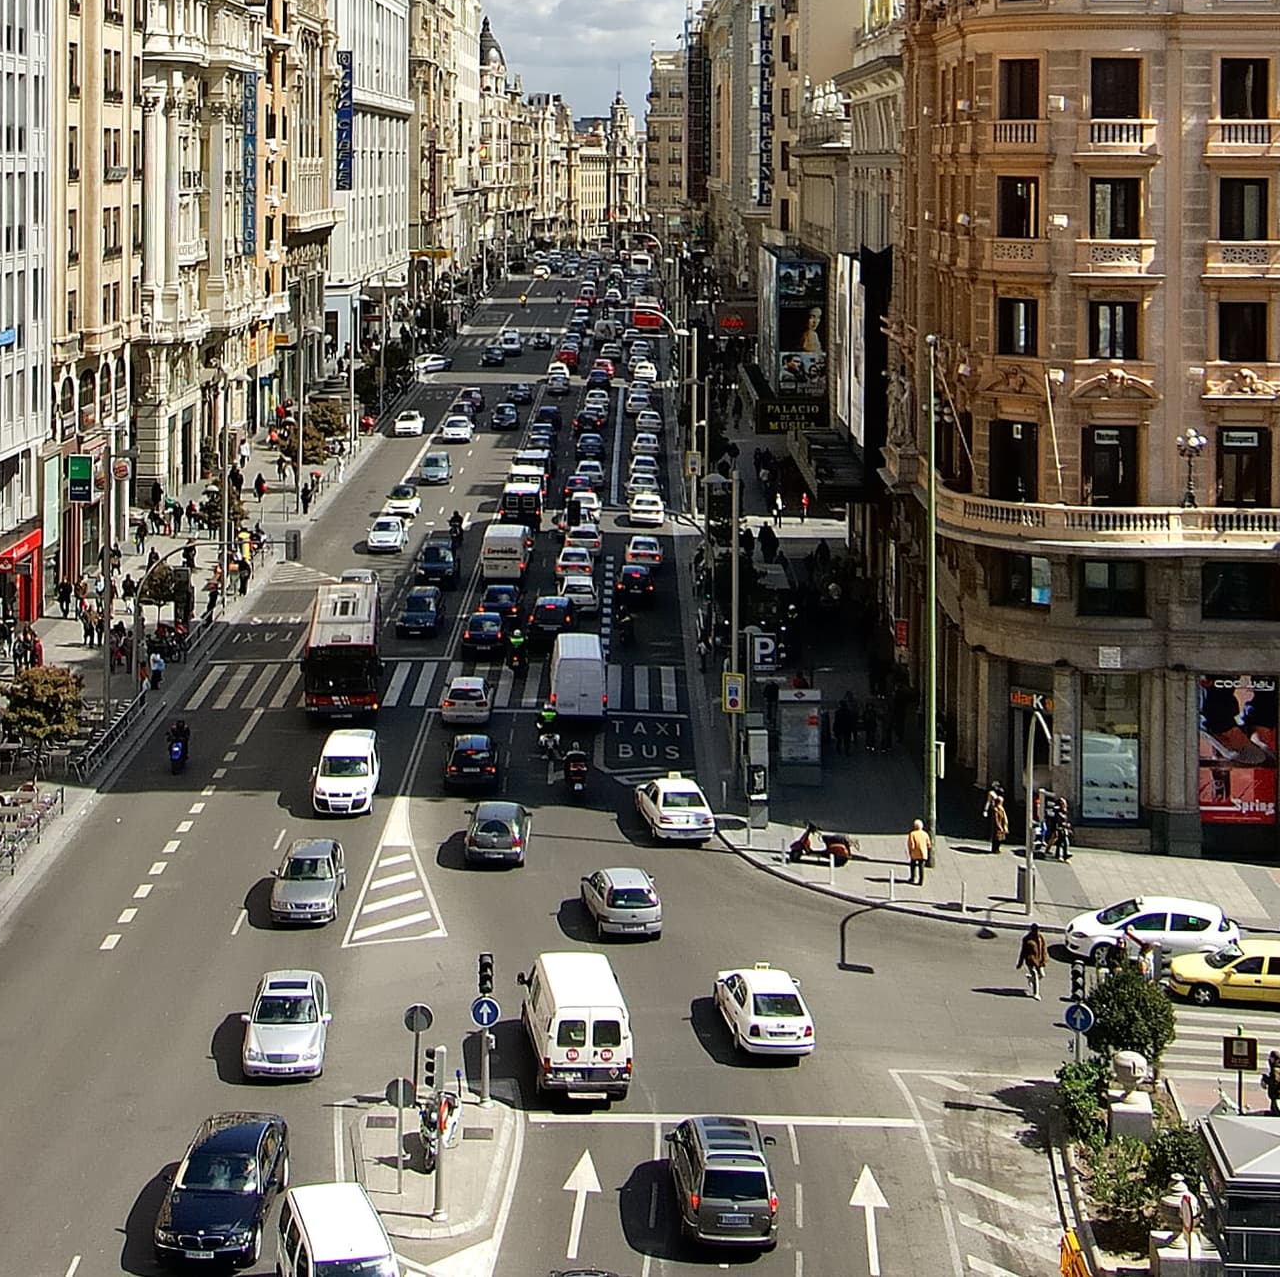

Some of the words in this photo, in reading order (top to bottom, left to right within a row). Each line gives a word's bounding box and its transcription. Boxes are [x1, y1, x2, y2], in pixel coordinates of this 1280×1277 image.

[761, 40, 773, 105] HOTEL
[245, 74, 255, 134] HOTEL
[761, 112, 773, 204] REGENTE
[767, 404, 820, 413] PALACIO
[754, 637, 775, 664] P
[611, 720, 680, 737] TAXI
[618, 743, 680, 760] BUS
[1232, 797, 1276, 816] Spring
